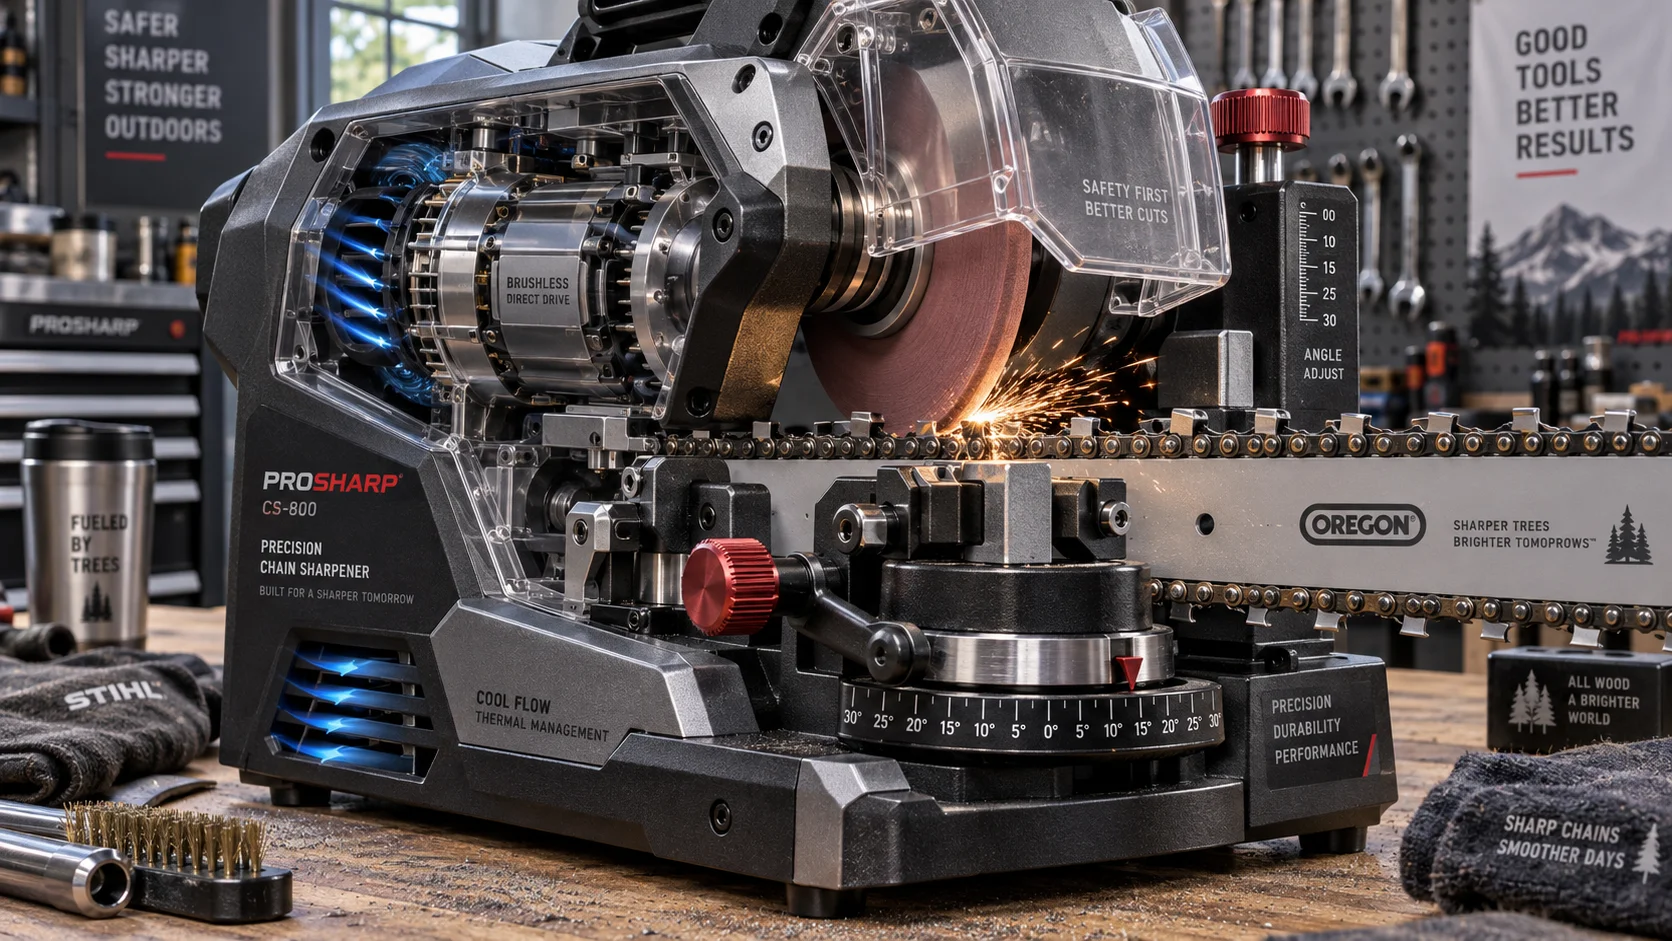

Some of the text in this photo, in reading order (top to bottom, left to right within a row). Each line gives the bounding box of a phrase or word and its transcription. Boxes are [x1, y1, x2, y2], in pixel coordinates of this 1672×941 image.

[104, 8, 179, 37] SAFER
[1516, 24, 1588, 57] GOOD
[104, 44, 209, 74] SHARPER
[1516, 57, 1602, 91] TOOLS
[104, 78, 223, 109] STRONGER
[1516, 91, 1619, 126] BETTER
[105, 114, 223, 144] OUTDOORS
[1516, 124, 1635, 160] RESULTS
[1082, 178, 1169, 204] SAFETY FIRST
[1085, 200, 1169, 224] BETTER CUTS
[1322, 208, 1336, 222] 00
[1323, 235, 1336, 248] 10
[1323, 261, 1336, 275] 15
[507, 276, 569, 290] BRUSHLESS
[507, 293, 570, 305] DIRECT DRIVE
[1322, 287, 1337, 301] 25
[1323, 313, 1337, 327] 30
[1304, 348, 1342, 362] ANGLE
[1303, 367, 1345, 380] ADJUST
[262, 500, 317, 517] CS-800
[71, 513, 128, 531] FUELED
[1453, 519, 1550, 532] SHARPER TREES
[71, 536, 92, 552] BY
[261, 539, 323, 555] PRECISION
[1453, 536, 1512, 548] BRIGHTER
[71, 556, 120, 573] TREES
[260, 560, 370, 579] CHAIN SHARPENER
[259, 585, 415, 605] BUILT FOR A SHARPER TOMORROW
[1568, 675, 1630, 690] ALL WOOD
[63, 680, 163, 711] STIHL
[476, 690, 551, 715] COOL FLOW
[1272, 694, 1332, 714] PRECISION
[1568, 693, 1640, 710] A BRIGHTER
[475, 710, 610, 742] THERMAL MANAGEMENT
[843, 709, 862, 725] 30°
[873, 713, 894, 729] 25°
[906, 717, 928, 733] 20°
[940, 721, 961, 735] 15°
[974, 722, 996, 738] 10°
[1011, 724, 1026, 739] 5°
[1043, 724, 1059, 739] 0°
[1075, 724, 1090, 739] 5°
[1103, 722, 1123, 738] 10°
[1134, 720, 1152, 736] 15°
[1162, 718, 1180, 734] 20°
[1186, 715, 1203, 731] 25°
[1273, 717, 1341, 739] DURABILITY
[1568, 711, 1611, 726] WORLD
[1275, 740, 1359, 765] PERFORMANCE
[1503, 814, 1621, 844] SHARP CHAINS
[1496, 838, 1626, 869] SMOOTHER DAYS
